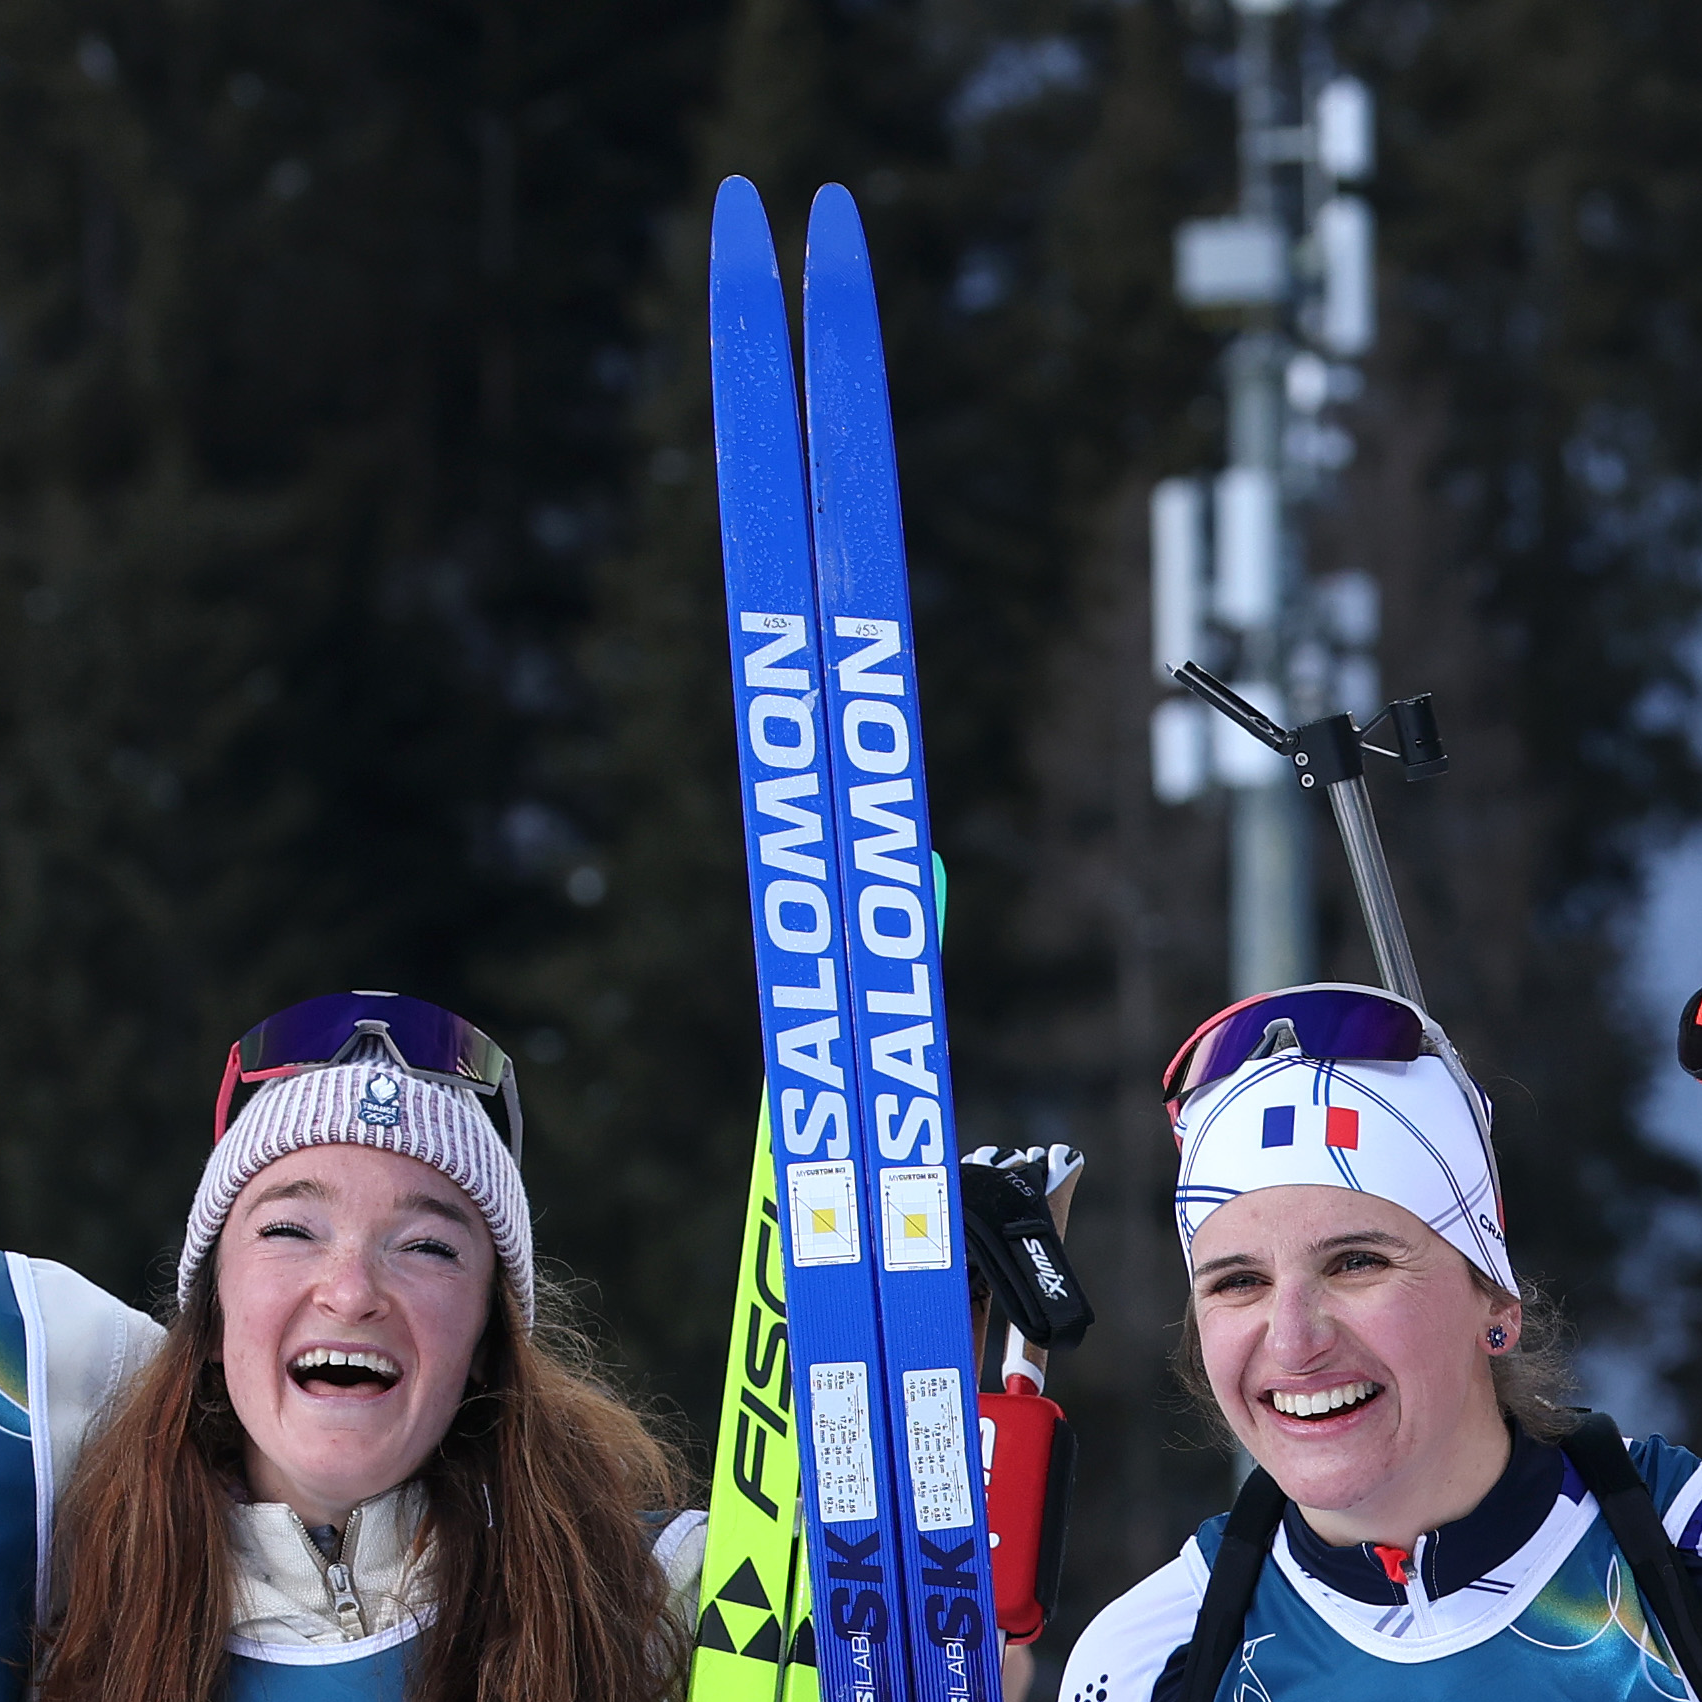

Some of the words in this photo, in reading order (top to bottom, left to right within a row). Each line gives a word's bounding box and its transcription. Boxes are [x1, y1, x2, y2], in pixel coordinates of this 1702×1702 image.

[740, 611, 851, 1160] SALOMON
[834, 617, 945, 1165] SALOMON
[362, 1101, 398, 1116] FRANCE
[1479, 1213, 1505, 1247] CRA
[733, 1197, 792, 1522] FISC
